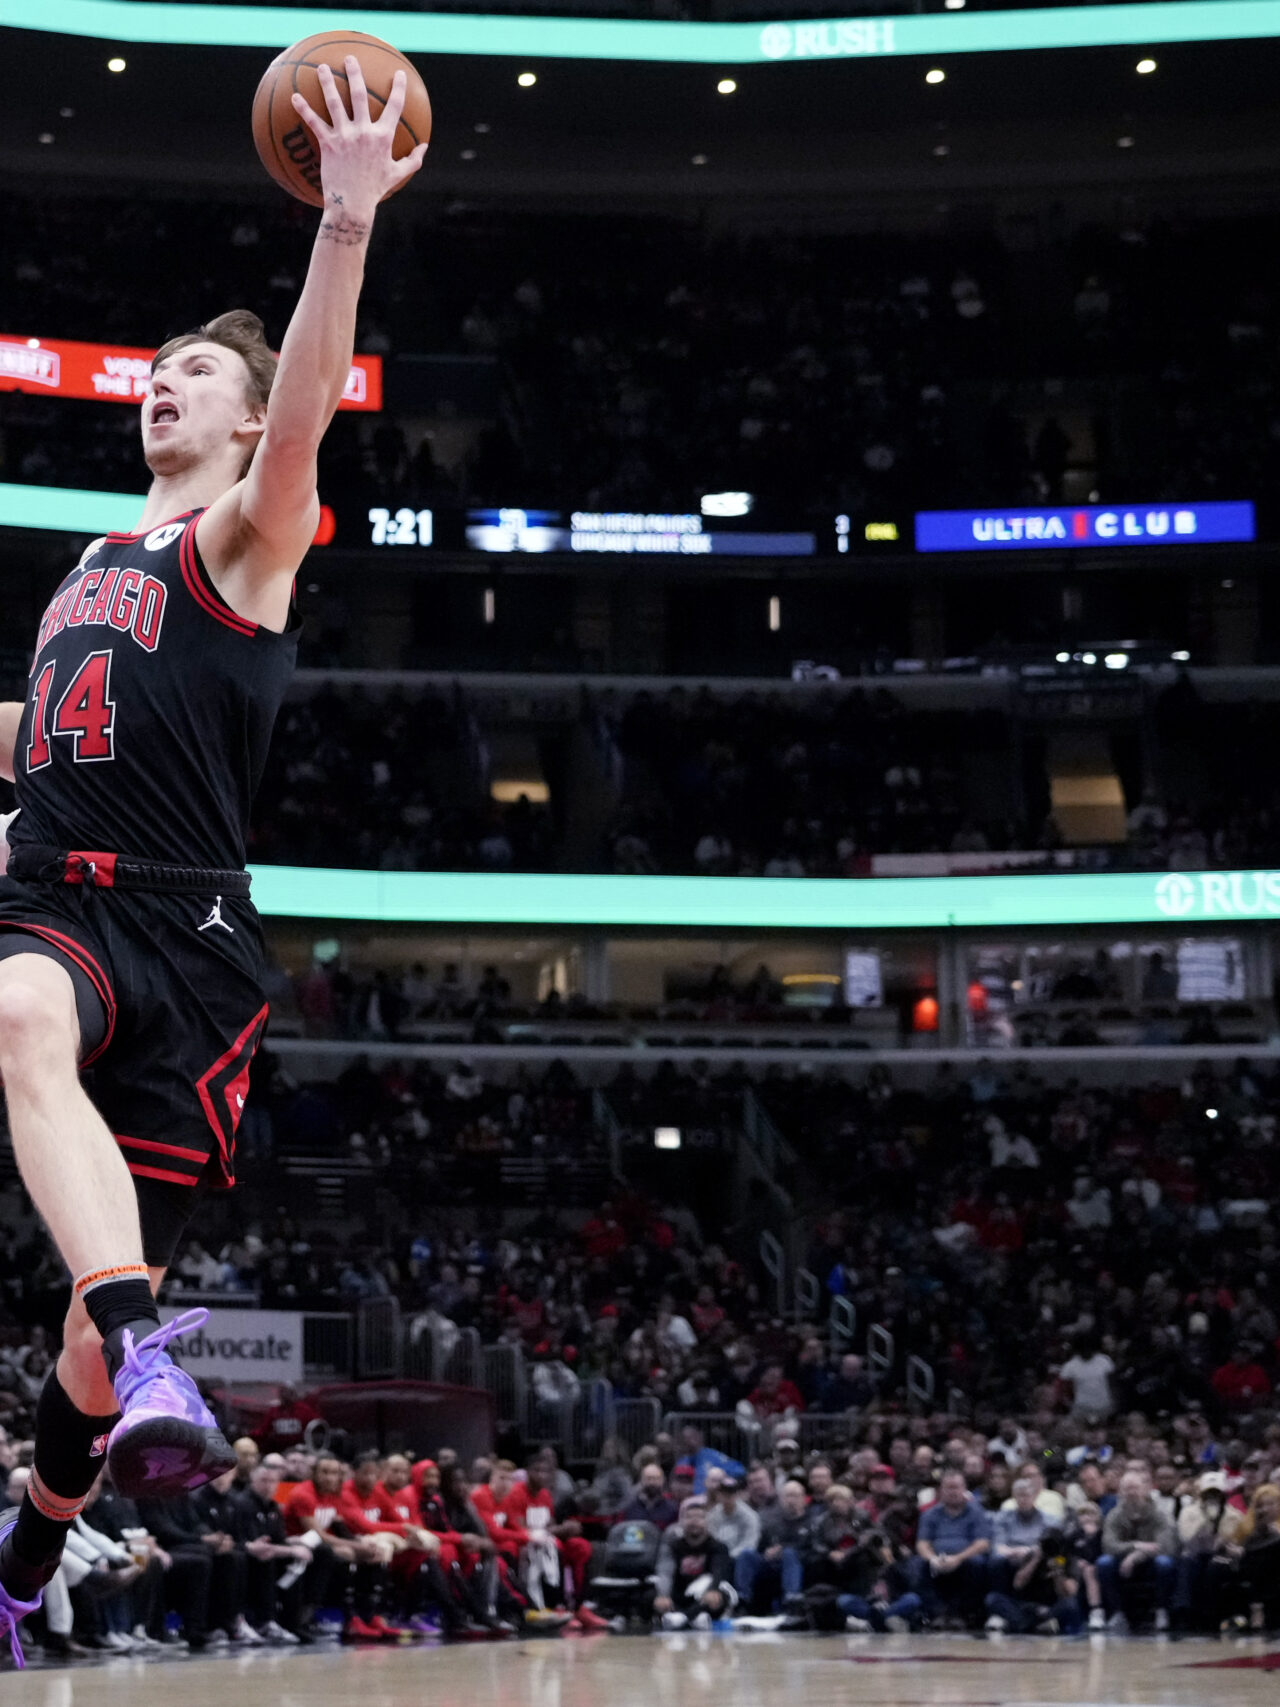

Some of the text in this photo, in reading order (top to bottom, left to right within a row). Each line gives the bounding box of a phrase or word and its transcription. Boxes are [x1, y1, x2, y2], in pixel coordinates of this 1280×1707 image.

[795, 20, 895, 57] RUSH
[368, 507, 433, 546] 7:21
[973, 511, 1197, 541] ULTRA CLUB
[26, 649, 116, 774] 14
